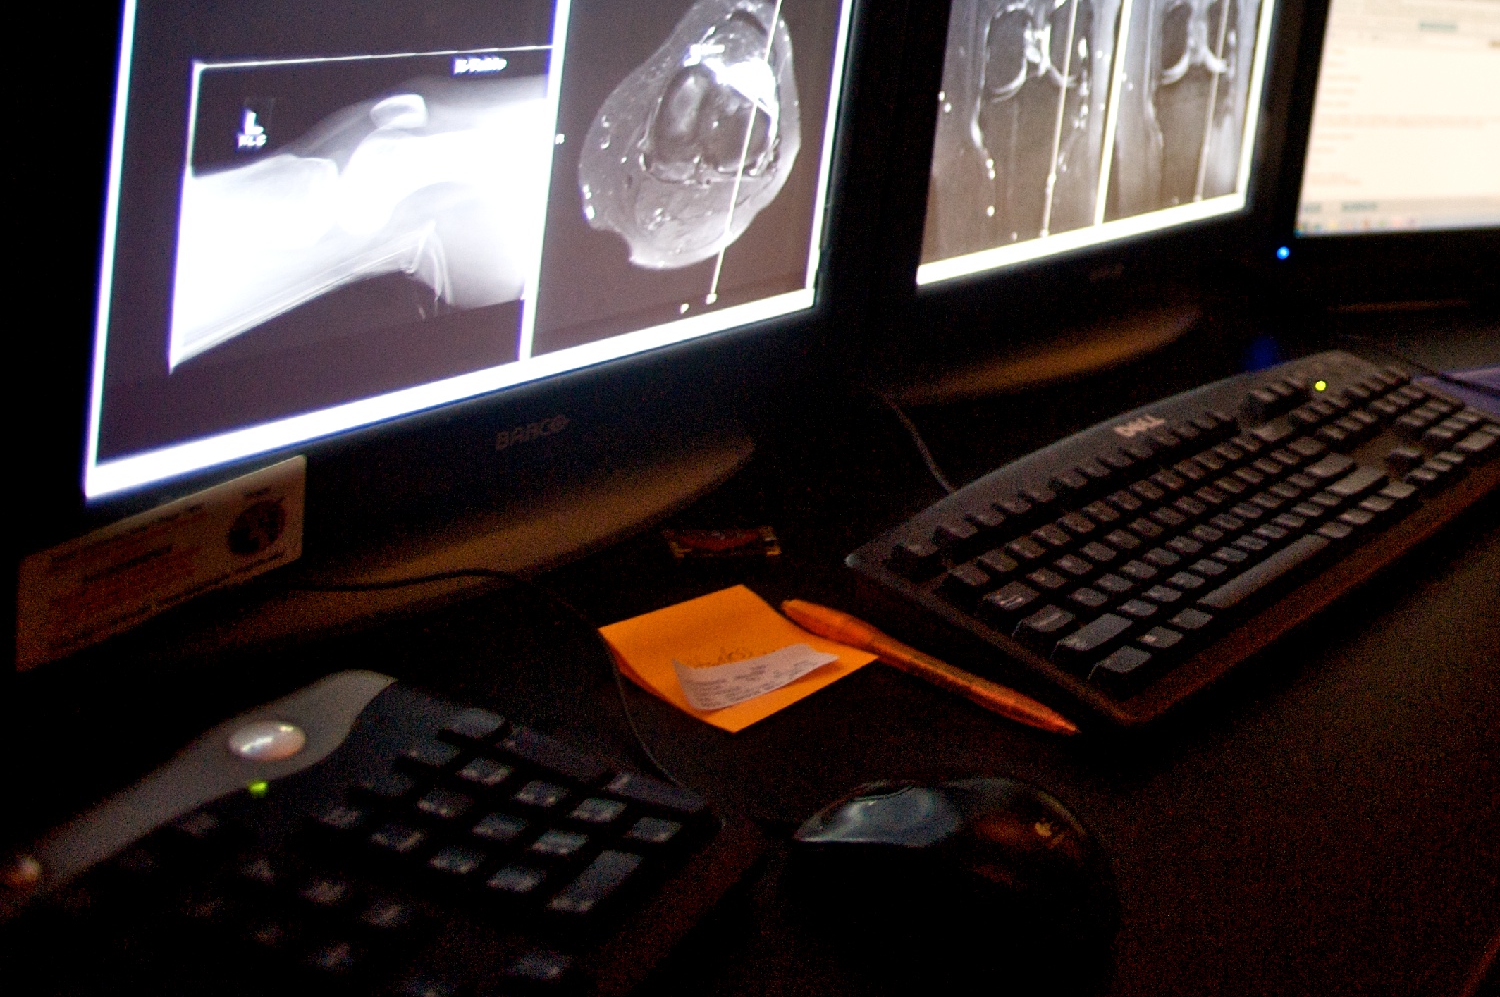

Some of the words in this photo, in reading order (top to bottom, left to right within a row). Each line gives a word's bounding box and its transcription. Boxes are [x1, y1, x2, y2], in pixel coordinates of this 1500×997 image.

[245, 109, 265, 135] L
[495, 415, 571, 451] BARCO
[1114, 414, 1165, 437] DELL
